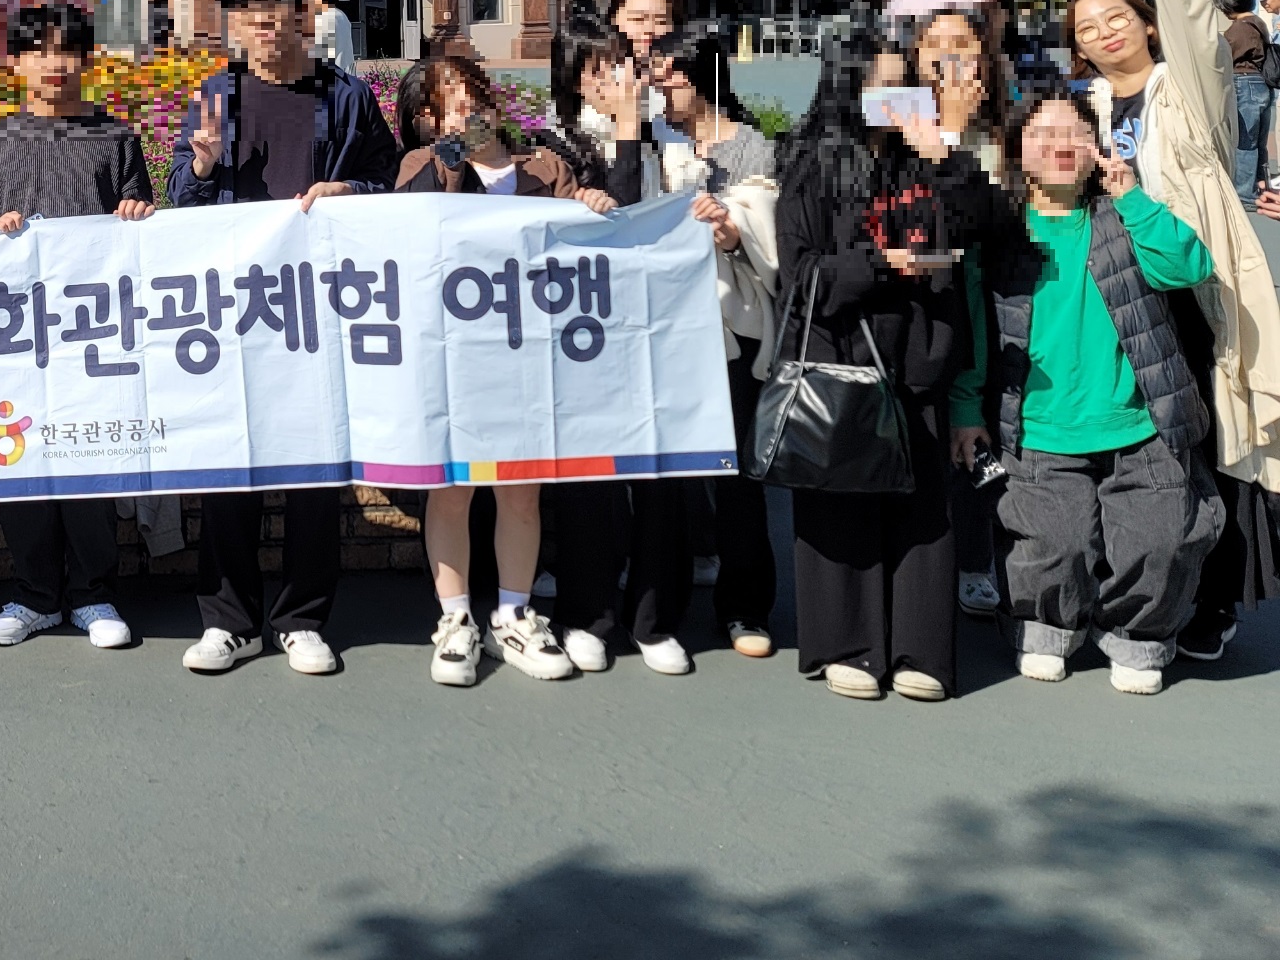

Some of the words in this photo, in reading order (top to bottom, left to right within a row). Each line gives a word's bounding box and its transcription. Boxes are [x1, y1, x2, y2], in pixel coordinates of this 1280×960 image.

[442, 253, 612, 363] 여행
[40, 417, 167, 446] 한국관광공사
[42, 451, 69, 459] KOREA
[70, 449, 105, 458] TOURISM
[107, 445, 167, 457] ORGANIZATION
